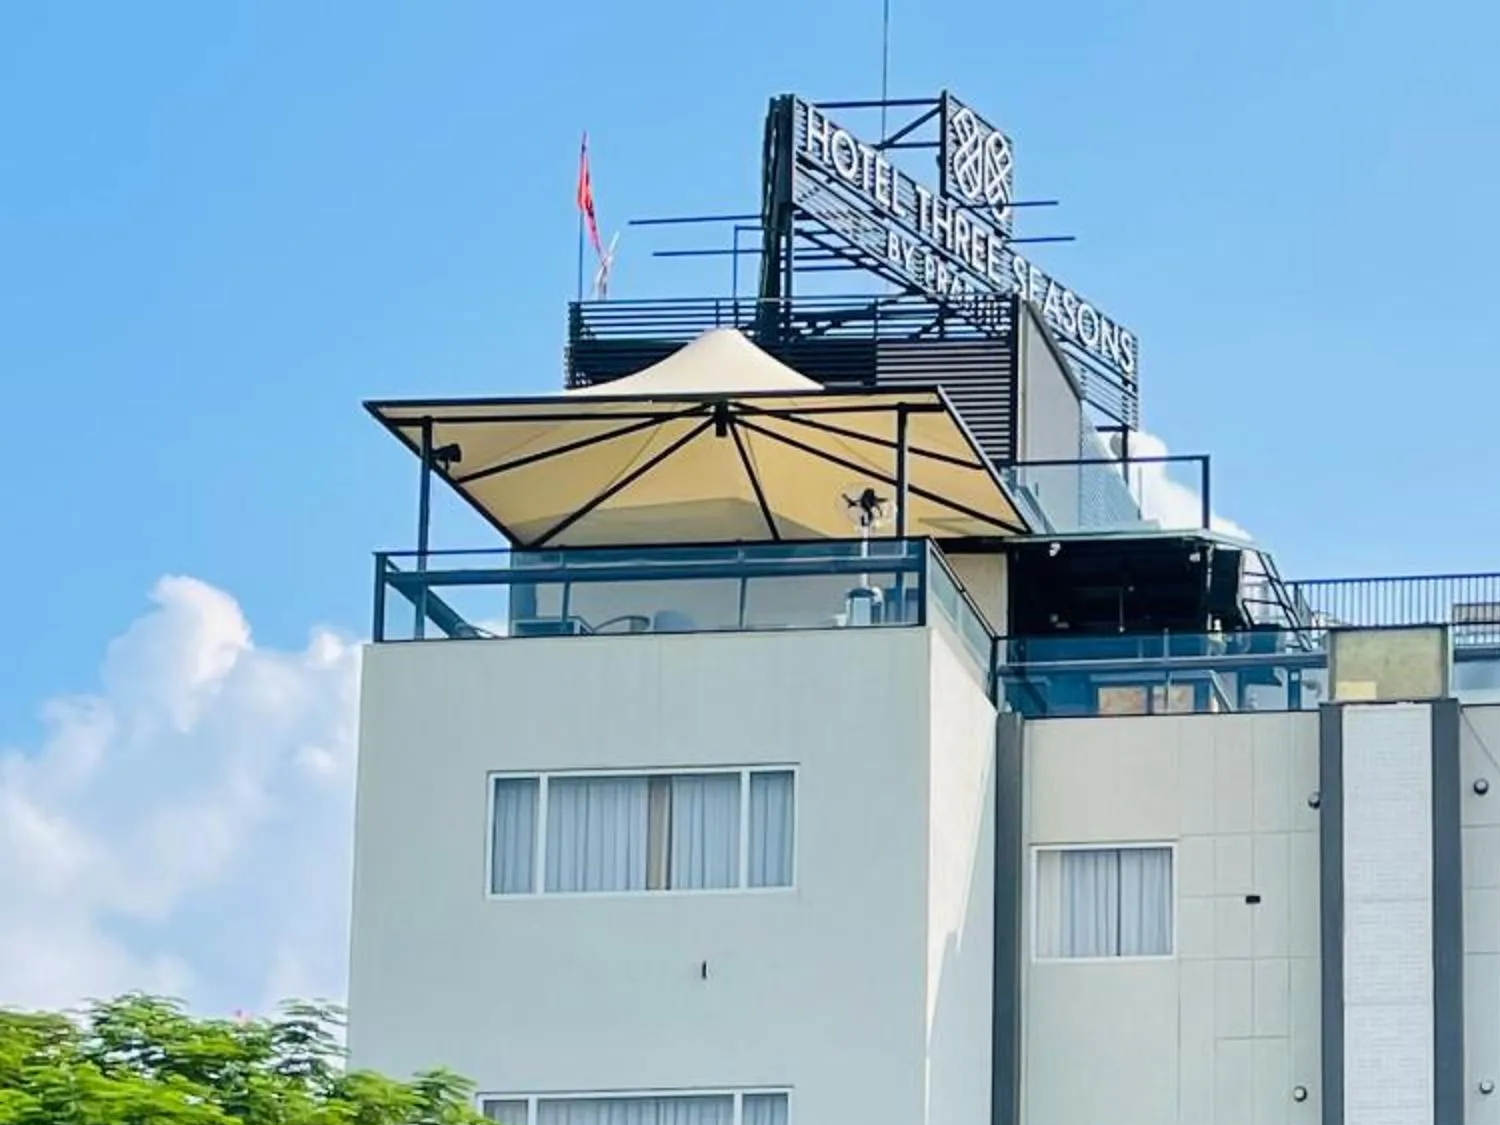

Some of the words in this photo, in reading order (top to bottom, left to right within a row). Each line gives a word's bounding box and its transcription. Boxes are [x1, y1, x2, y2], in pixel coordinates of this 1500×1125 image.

[806, 105, 906, 218] HOTEL
[915, 184, 1003, 285] THREE
[1012, 255, 1135, 375] SEASONS
[887, 230, 917, 273] BY
